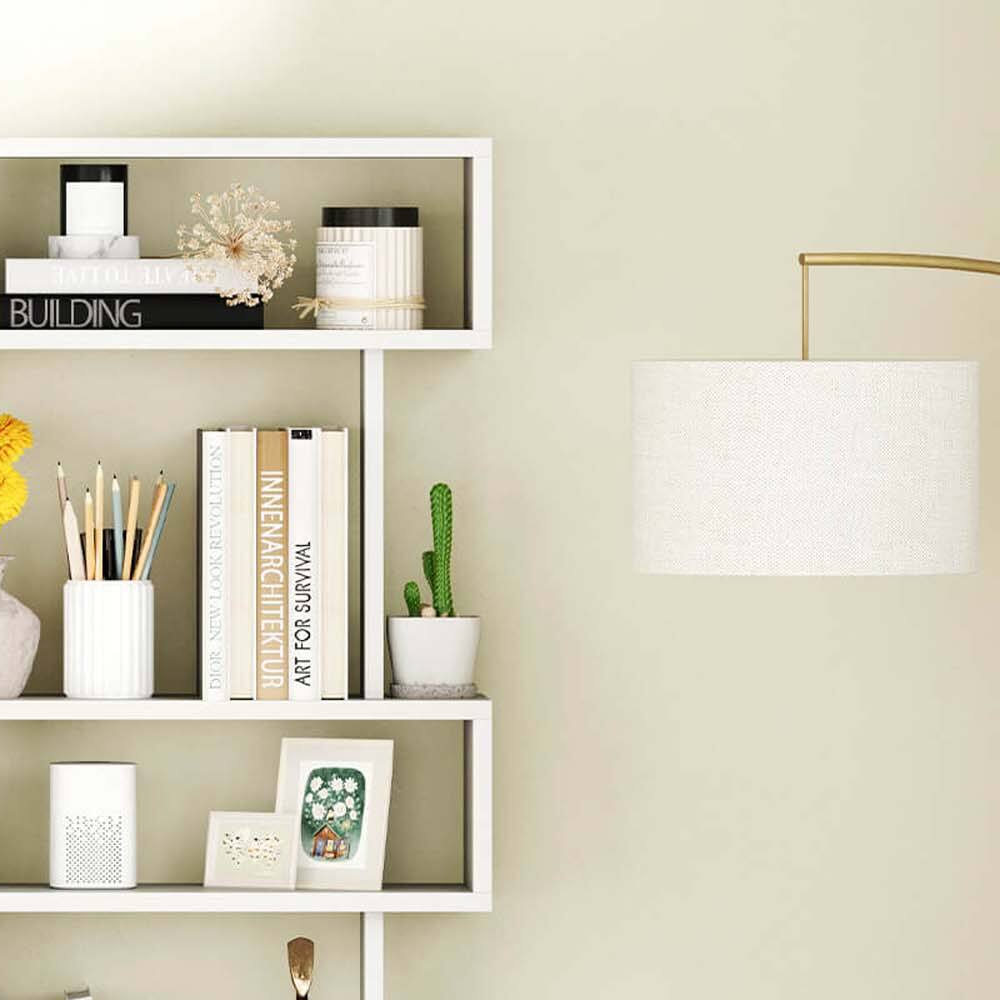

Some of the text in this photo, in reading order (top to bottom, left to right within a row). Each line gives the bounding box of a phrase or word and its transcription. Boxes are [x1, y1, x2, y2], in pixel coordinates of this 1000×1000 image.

[11, 299, 141, 328] BUILDING
[209, 446, 223, 550] REVOLUTION
[209, 555, 223, 599] LOOK
[261, 471, 284, 688] INNENARCHITEKTUR
[295, 541, 311, 686] ART FOR SURVIVAL
[209, 605, 223, 640] NEW
